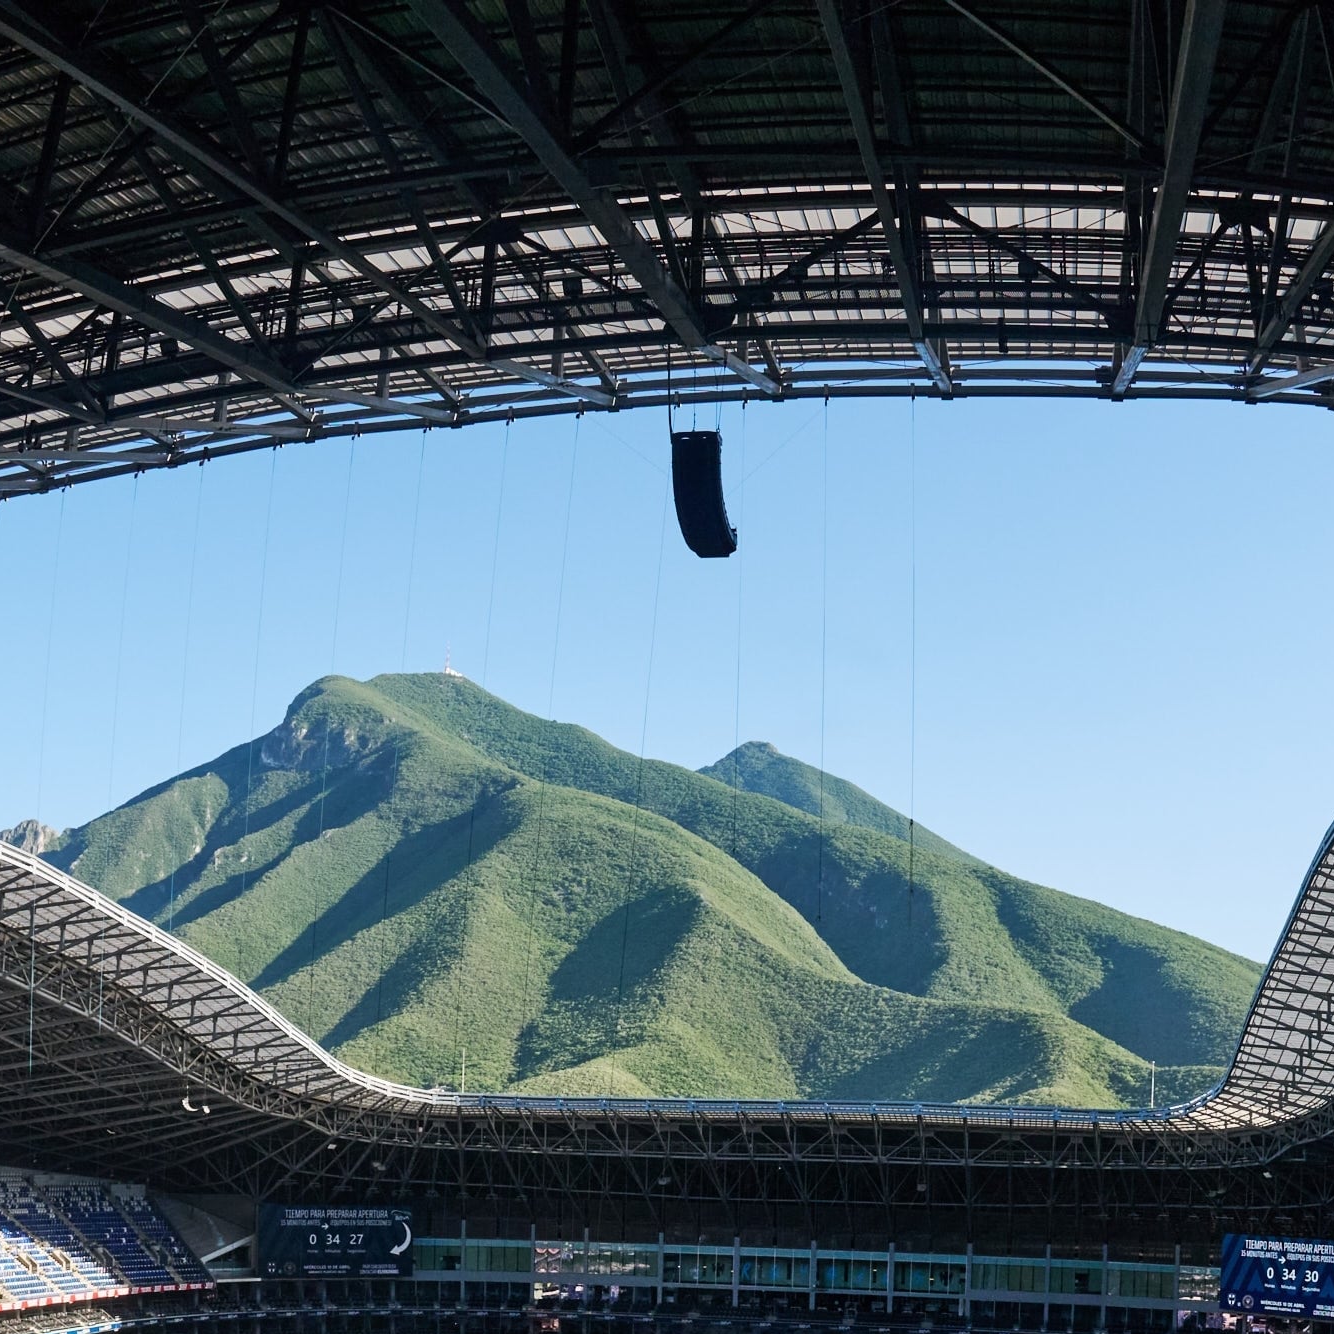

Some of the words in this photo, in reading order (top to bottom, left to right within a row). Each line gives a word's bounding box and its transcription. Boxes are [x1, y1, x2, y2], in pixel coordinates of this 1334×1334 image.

[285, 1209, 309, 1219] TIEMPO
[310, 1209, 325, 1219] PARA
[326, 1209, 357, 1219] PREPARAR
[357, 1209, 388, 1219] APERTURA
[309, 1233, 317, 1245] 0
[326, 1233, 340, 1245] 34
[349, 1233, 364, 1245] 27
[1245, 1239, 1267, 1250] TIEMPO
[1268, 1241, 1283, 1251] PARA
[1284, 1242, 1313, 1254] PREPARAR
[1246, 1250, 1265, 1258] MINUTOS
[1266, 1267, 1274, 1279] 0
[1282, 1268, 1296, 1281] 34
[1304, 1270, 1319, 1283] 30
